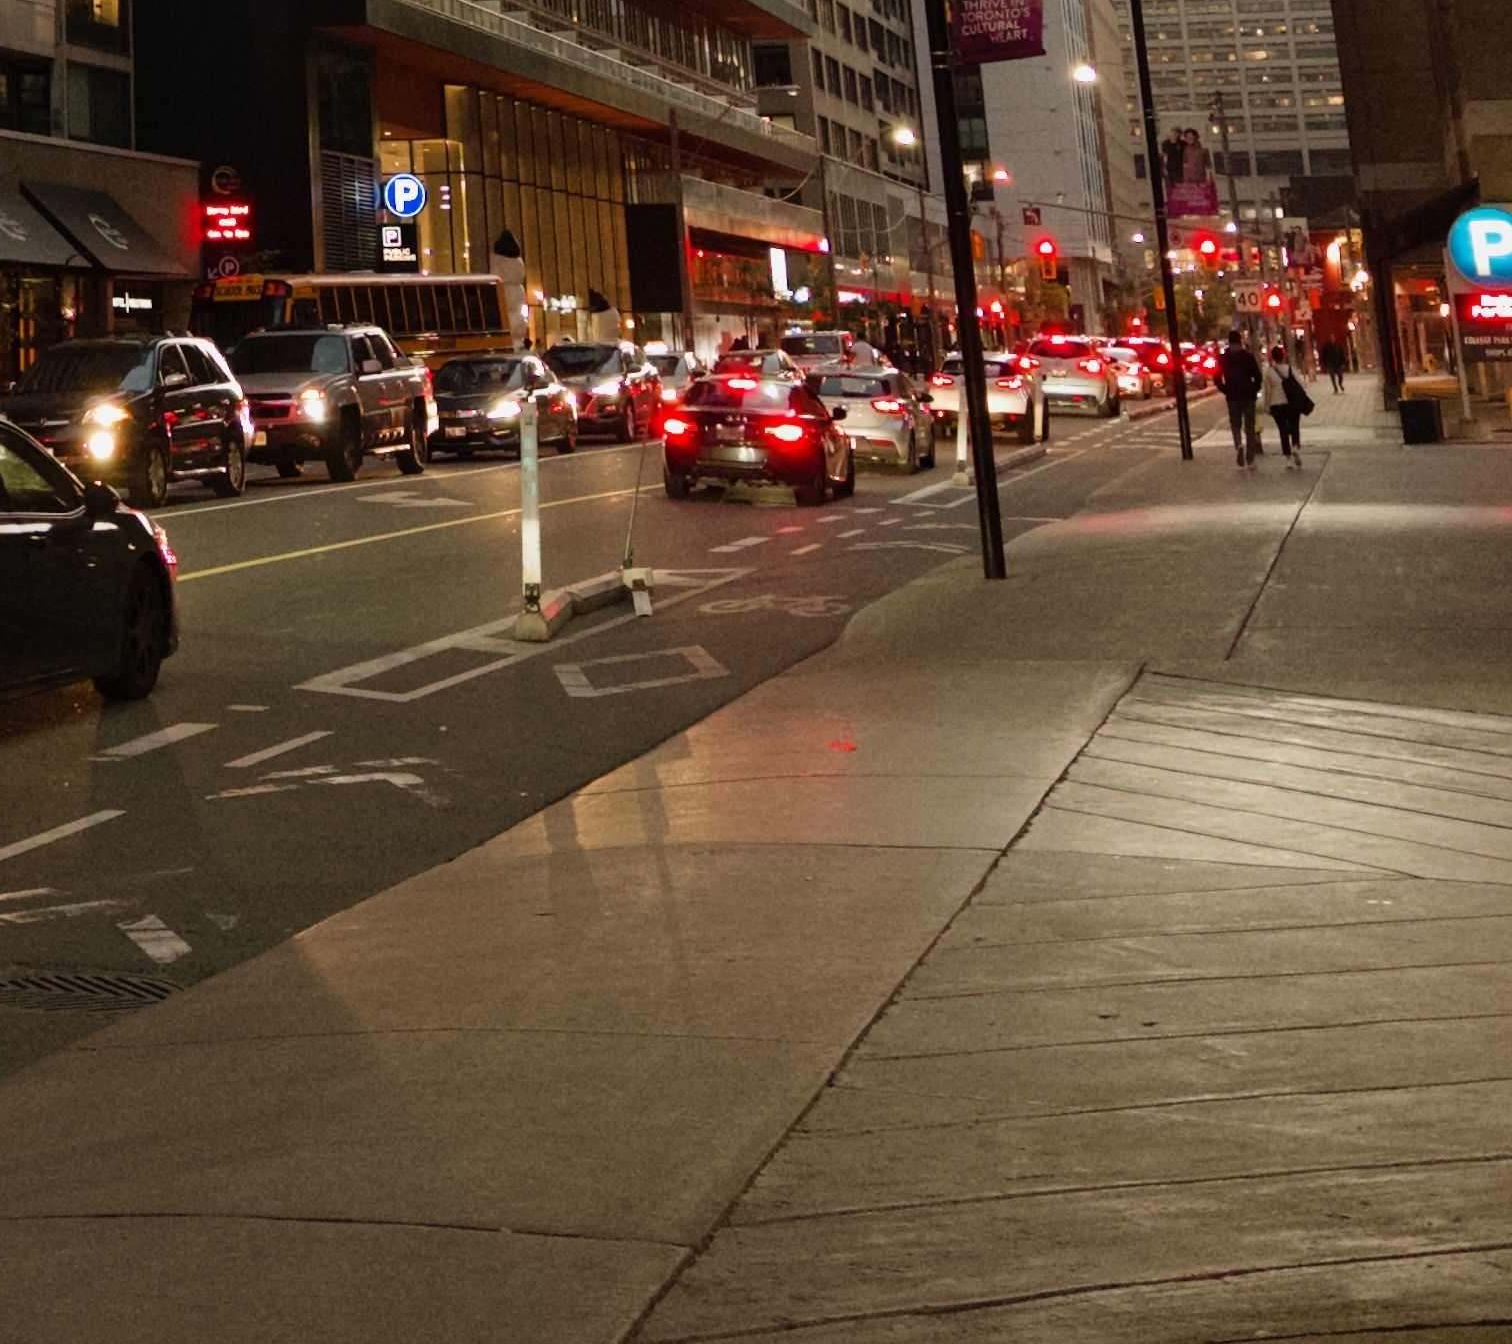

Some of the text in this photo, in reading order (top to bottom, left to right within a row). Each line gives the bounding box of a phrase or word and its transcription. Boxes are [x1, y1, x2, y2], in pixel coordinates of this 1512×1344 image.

[961, 7, 1030, 22] TORONTO'S
[962, 20, 1020, 36] CULTURAL
[990, 29, 1028, 43] HEART
[395, 179, 419, 212] P
[1469, 220, 1512, 276] P
[1238, 292, 1259, 306] 40
